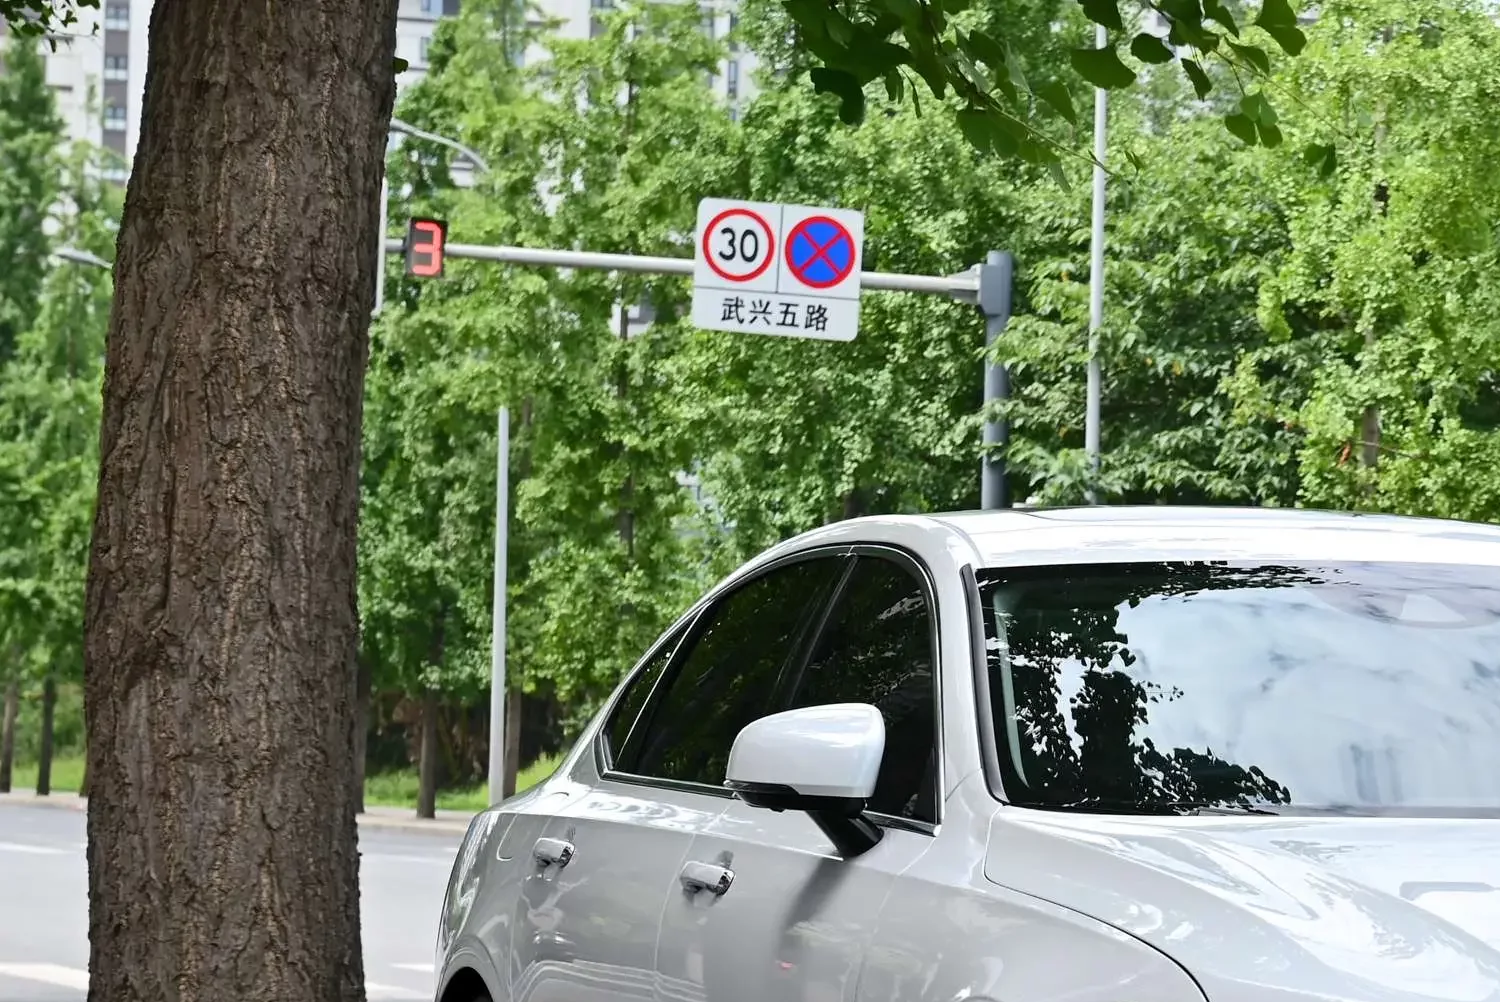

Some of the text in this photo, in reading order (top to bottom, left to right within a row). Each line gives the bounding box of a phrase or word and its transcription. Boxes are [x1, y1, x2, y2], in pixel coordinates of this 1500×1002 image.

[413, 221, 442, 275] 3
[718, 227, 759, 263] 30
[721, 296, 829, 332] 武兴五路
